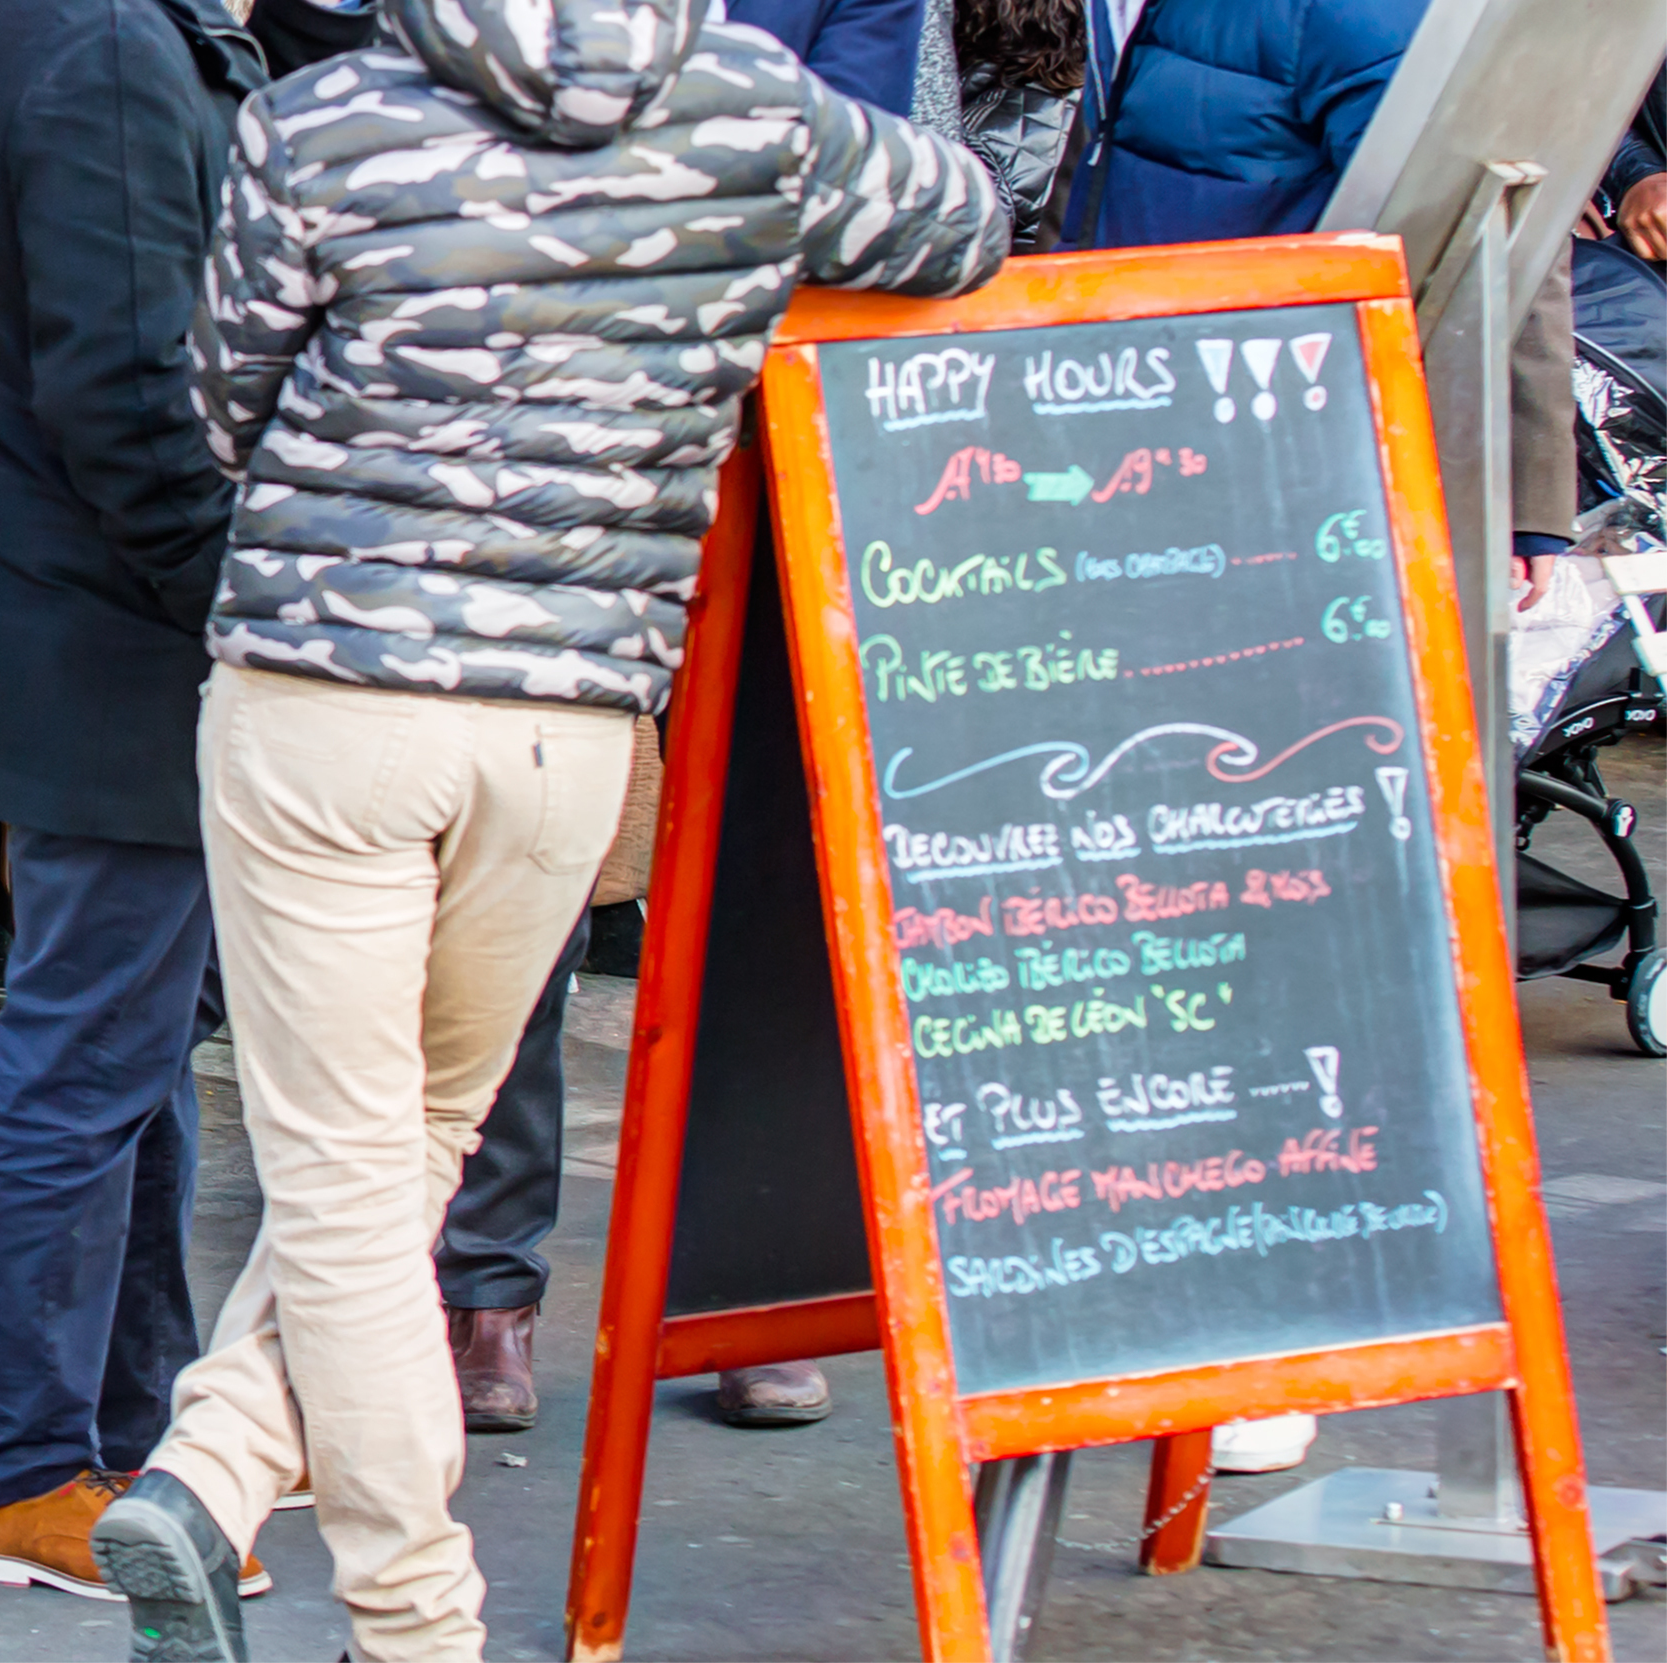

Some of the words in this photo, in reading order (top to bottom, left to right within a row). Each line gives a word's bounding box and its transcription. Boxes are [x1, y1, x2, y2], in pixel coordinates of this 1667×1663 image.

[865, 347, 997, 420] HAPPY
[1023, 346, 1178, 402] HOURS
[857, 633, 968, 703] PINTE
[971, 647, 1017, 690] DE
[1021, 630, 1120, 688] BIÈRE
[923, 1102, 968, 1145] ET
[975, 1081, 1083, 1132] PLUS
